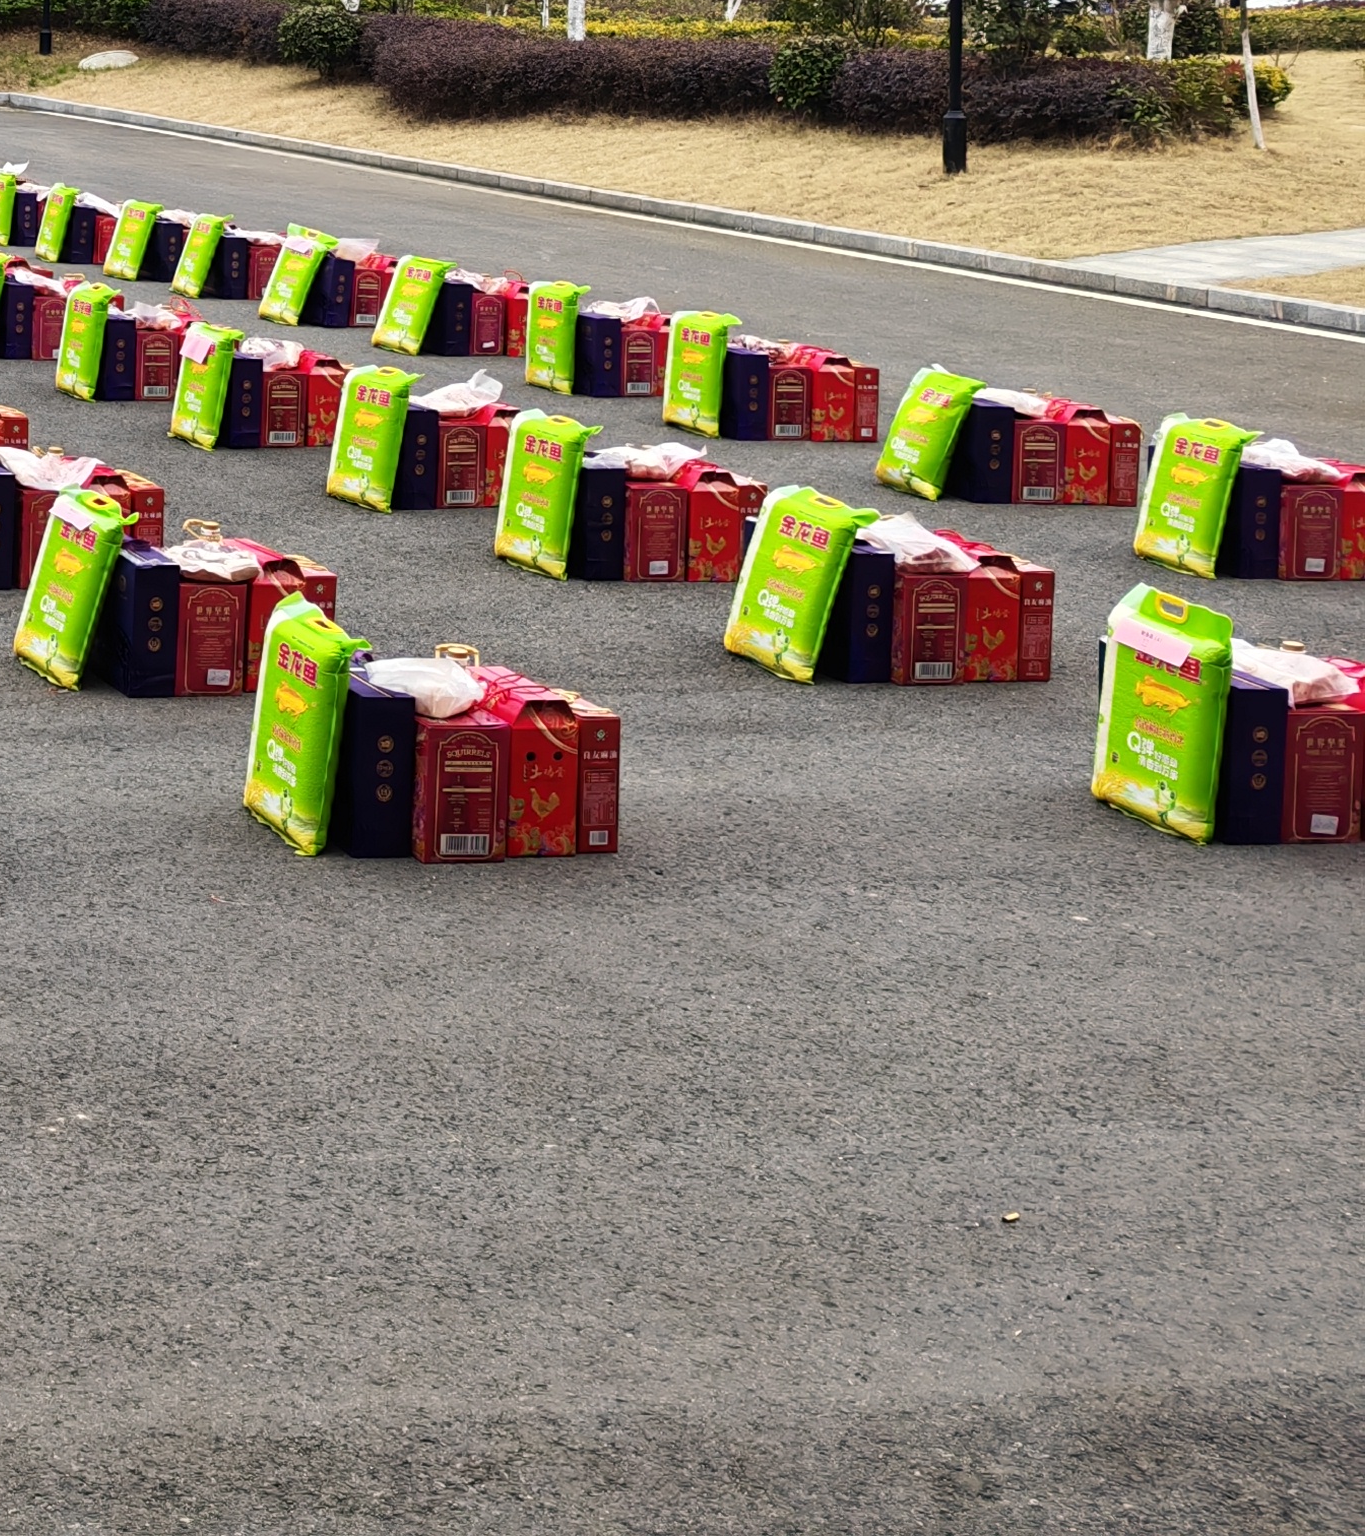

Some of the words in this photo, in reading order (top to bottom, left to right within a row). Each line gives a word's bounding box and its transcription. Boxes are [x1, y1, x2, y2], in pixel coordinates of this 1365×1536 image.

[537, 295, 564, 314] 金龙鱼
[681, 327, 711, 346] 金龙鱼
[356, 385, 392, 407] 金龙鱼
[524, 434, 564, 463] 金龙鱼
[1174, 436, 1221, 465] 金龙鱼
[778, 514, 832, 551] 金龙鱼
[196, 605, 231, 616] 世界坚果
[277, 642, 319, 689] 金龙鱼
[446, 748, 491, 759] SQUIRRELS
[583, 750, 618, 761] 良友麻油
